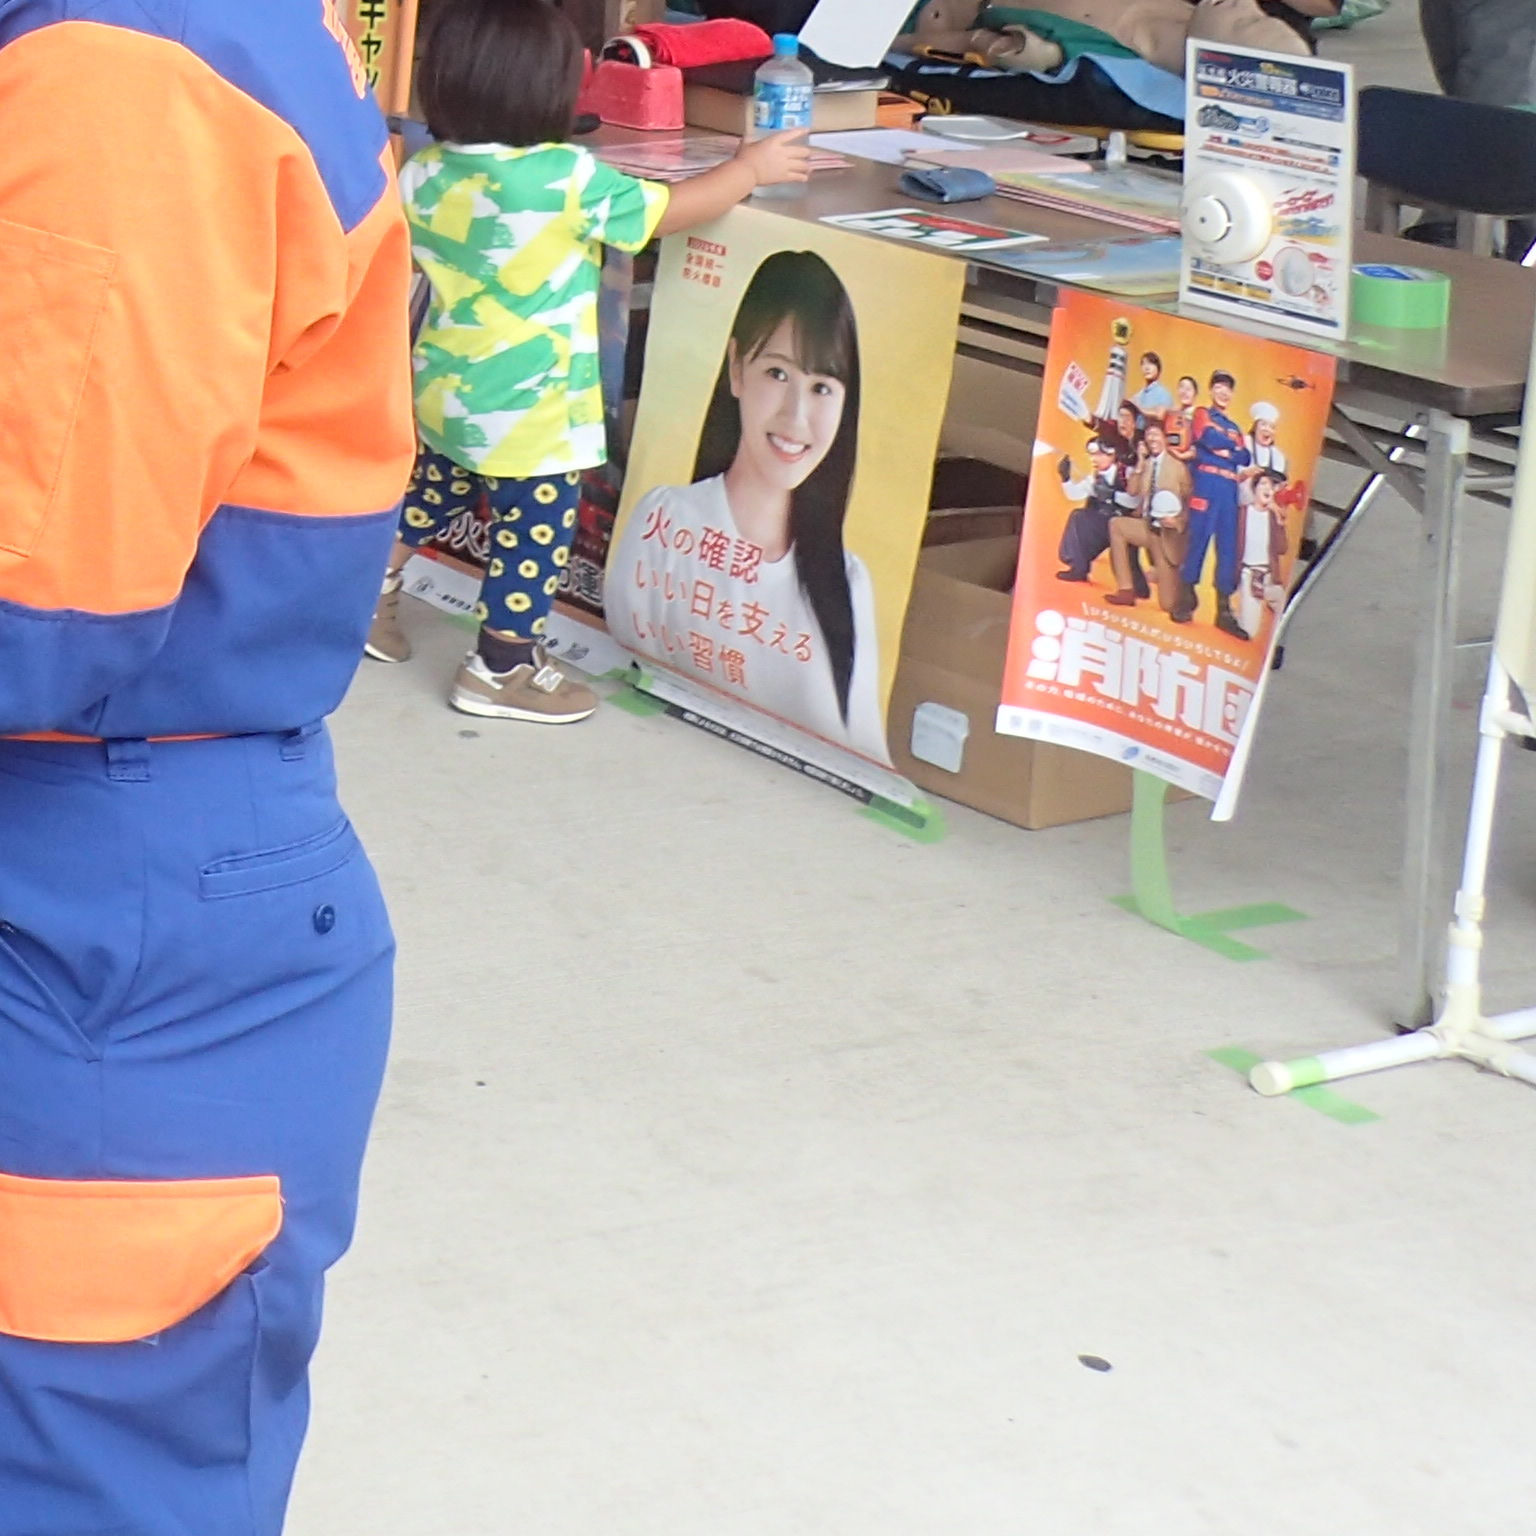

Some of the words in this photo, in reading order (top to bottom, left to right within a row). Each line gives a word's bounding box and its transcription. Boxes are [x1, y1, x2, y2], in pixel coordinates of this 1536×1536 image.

[641, 505, 764, 584] 火の確認
[632, 611, 748, 690] いい習慣
[635, 559, 812, 663] いい日を支える
[1025, 609, 1259, 747] 消防団
